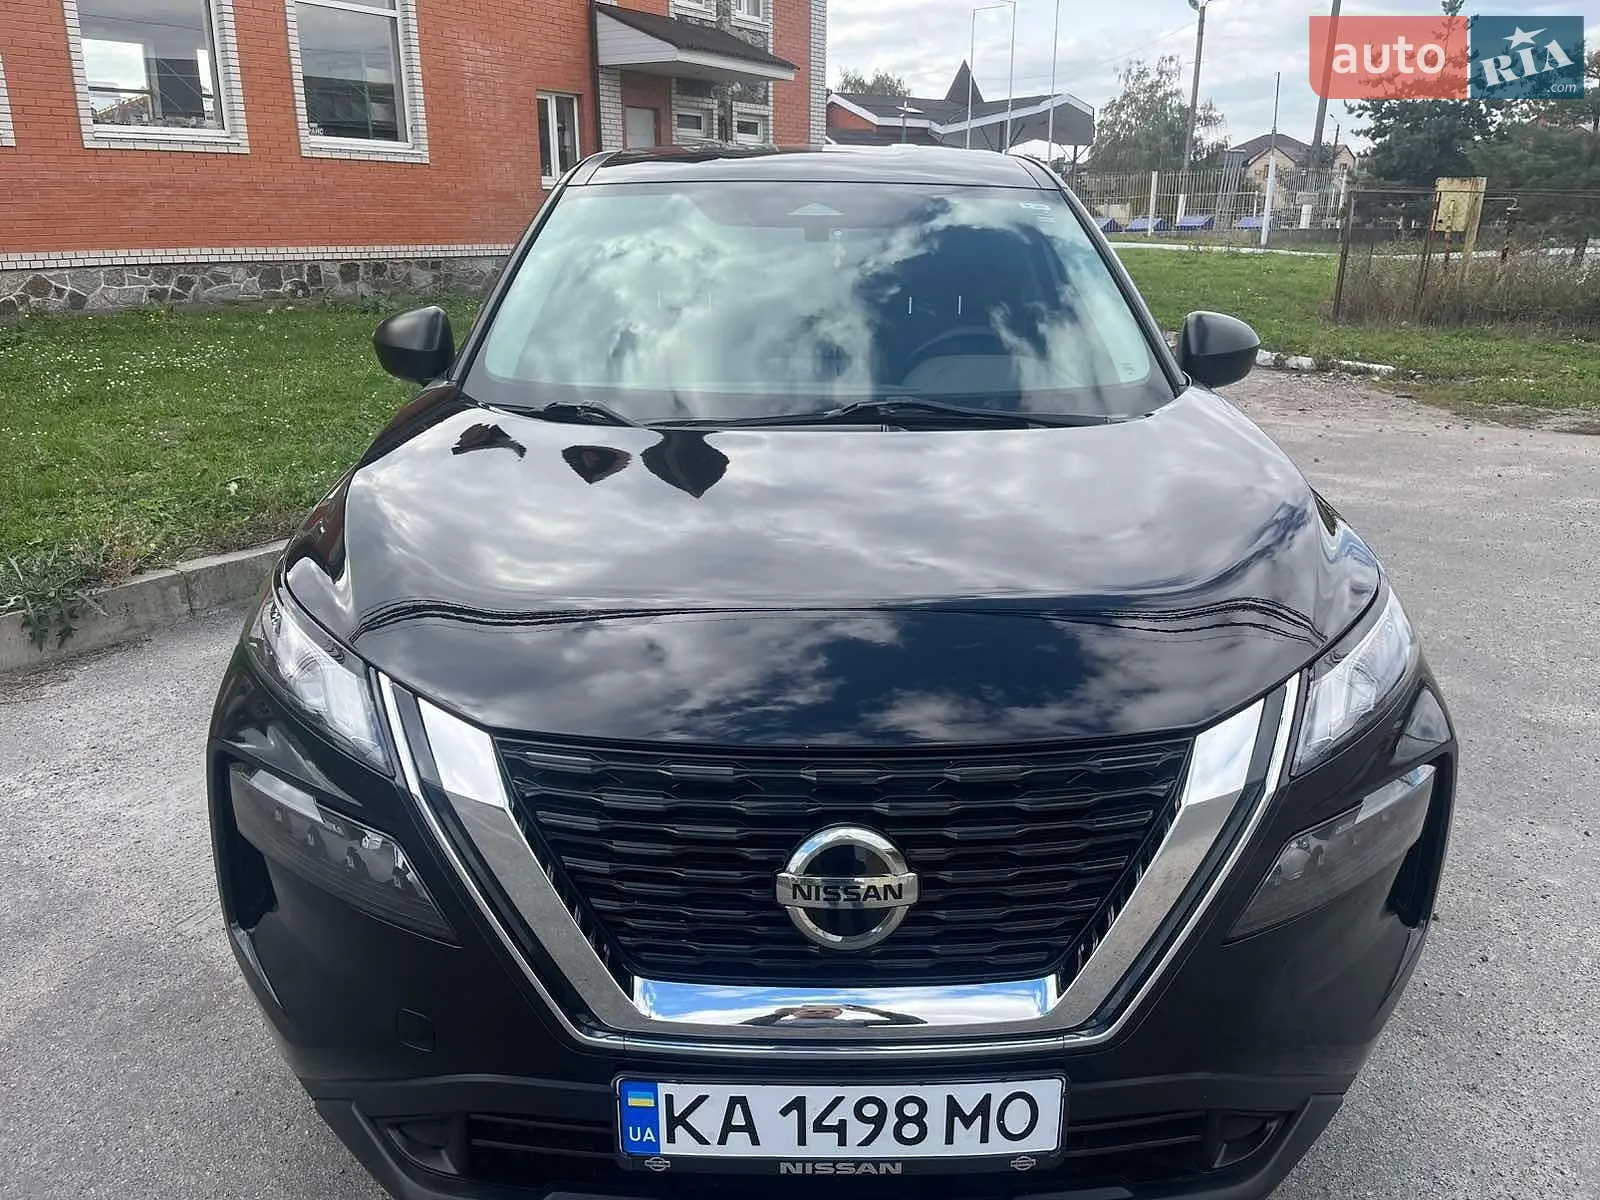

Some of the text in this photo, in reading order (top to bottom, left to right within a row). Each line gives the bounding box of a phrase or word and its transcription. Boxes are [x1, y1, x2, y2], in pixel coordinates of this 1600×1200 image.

[792, 883, 904, 902] NISSAN
[664, 1091, 1039, 1147] KA 1498 MO
[629, 1126, 656, 1143] UA
[779, 1161, 902, 1175] NISSAN
